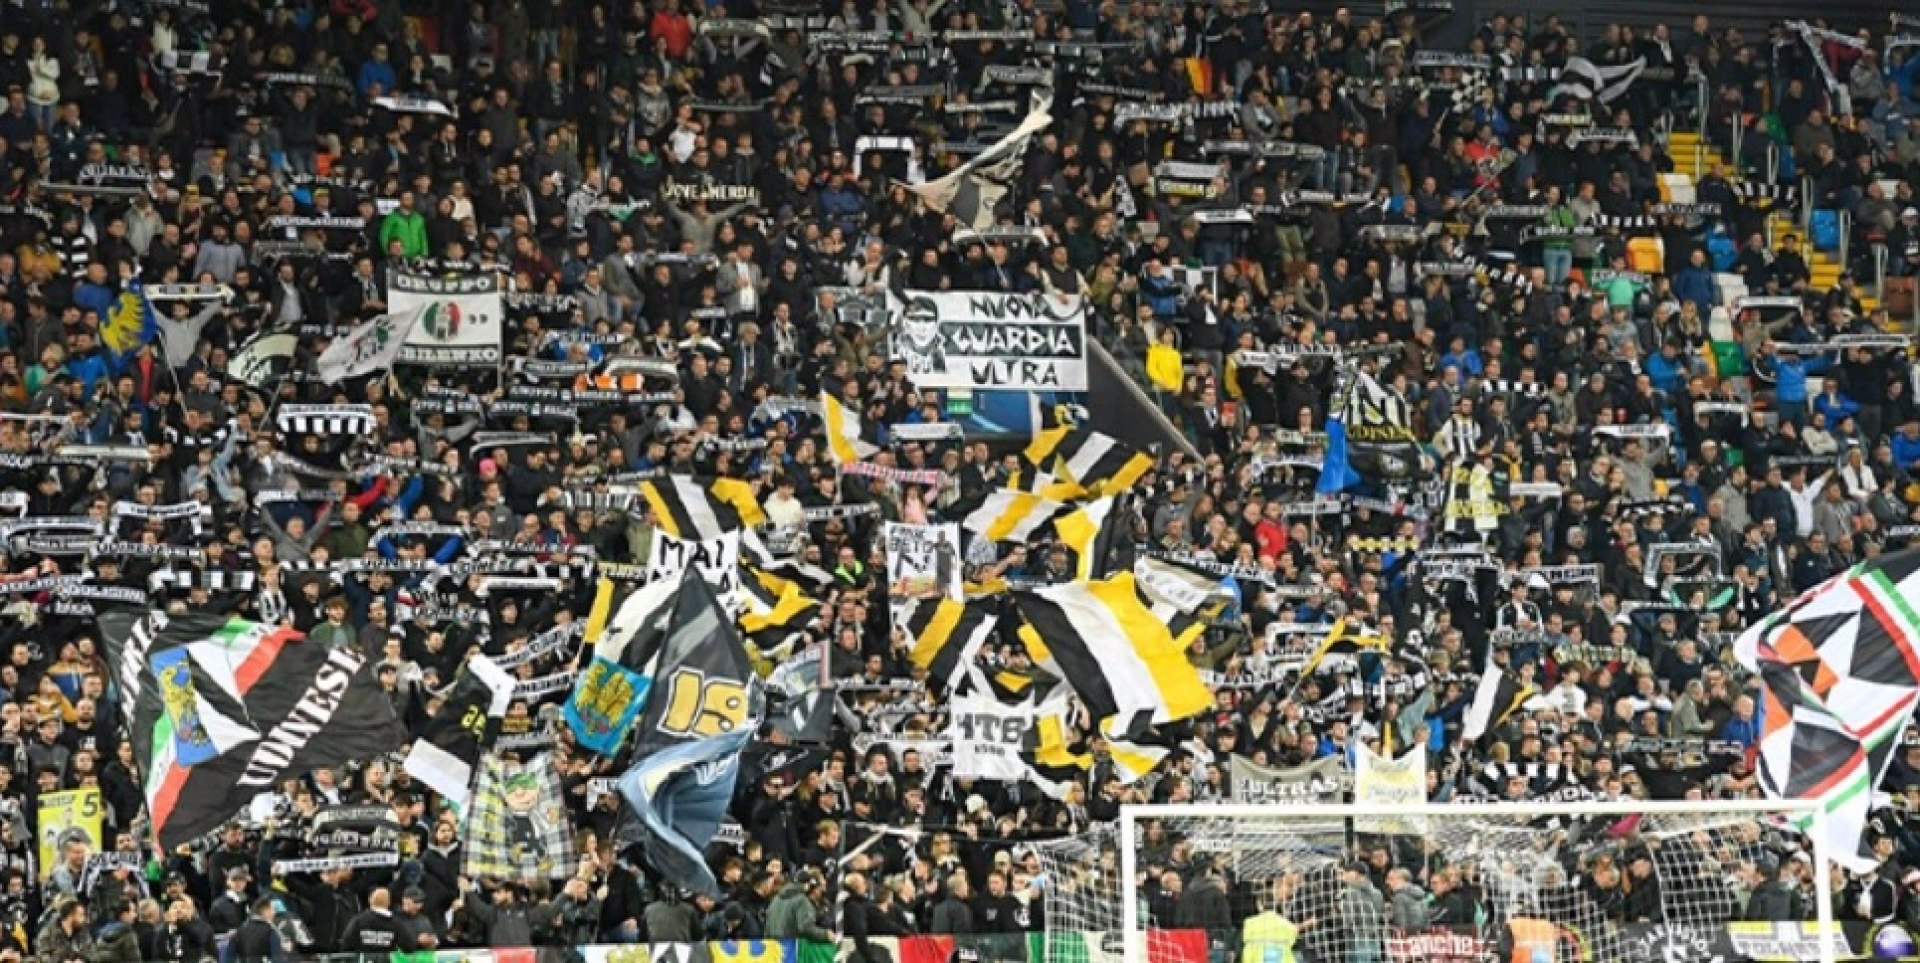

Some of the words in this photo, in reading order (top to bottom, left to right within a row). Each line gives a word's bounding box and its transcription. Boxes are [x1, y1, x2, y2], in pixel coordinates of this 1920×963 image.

[397, 274, 492, 292] GRUPPO
[952, 327, 1075, 354] GUARDIA
[972, 362, 1060, 386] ULTRA
[660, 534, 723, 569] MAI
[236, 645, 367, 786] UDINESE
[82, 793, 98, 817] 5
